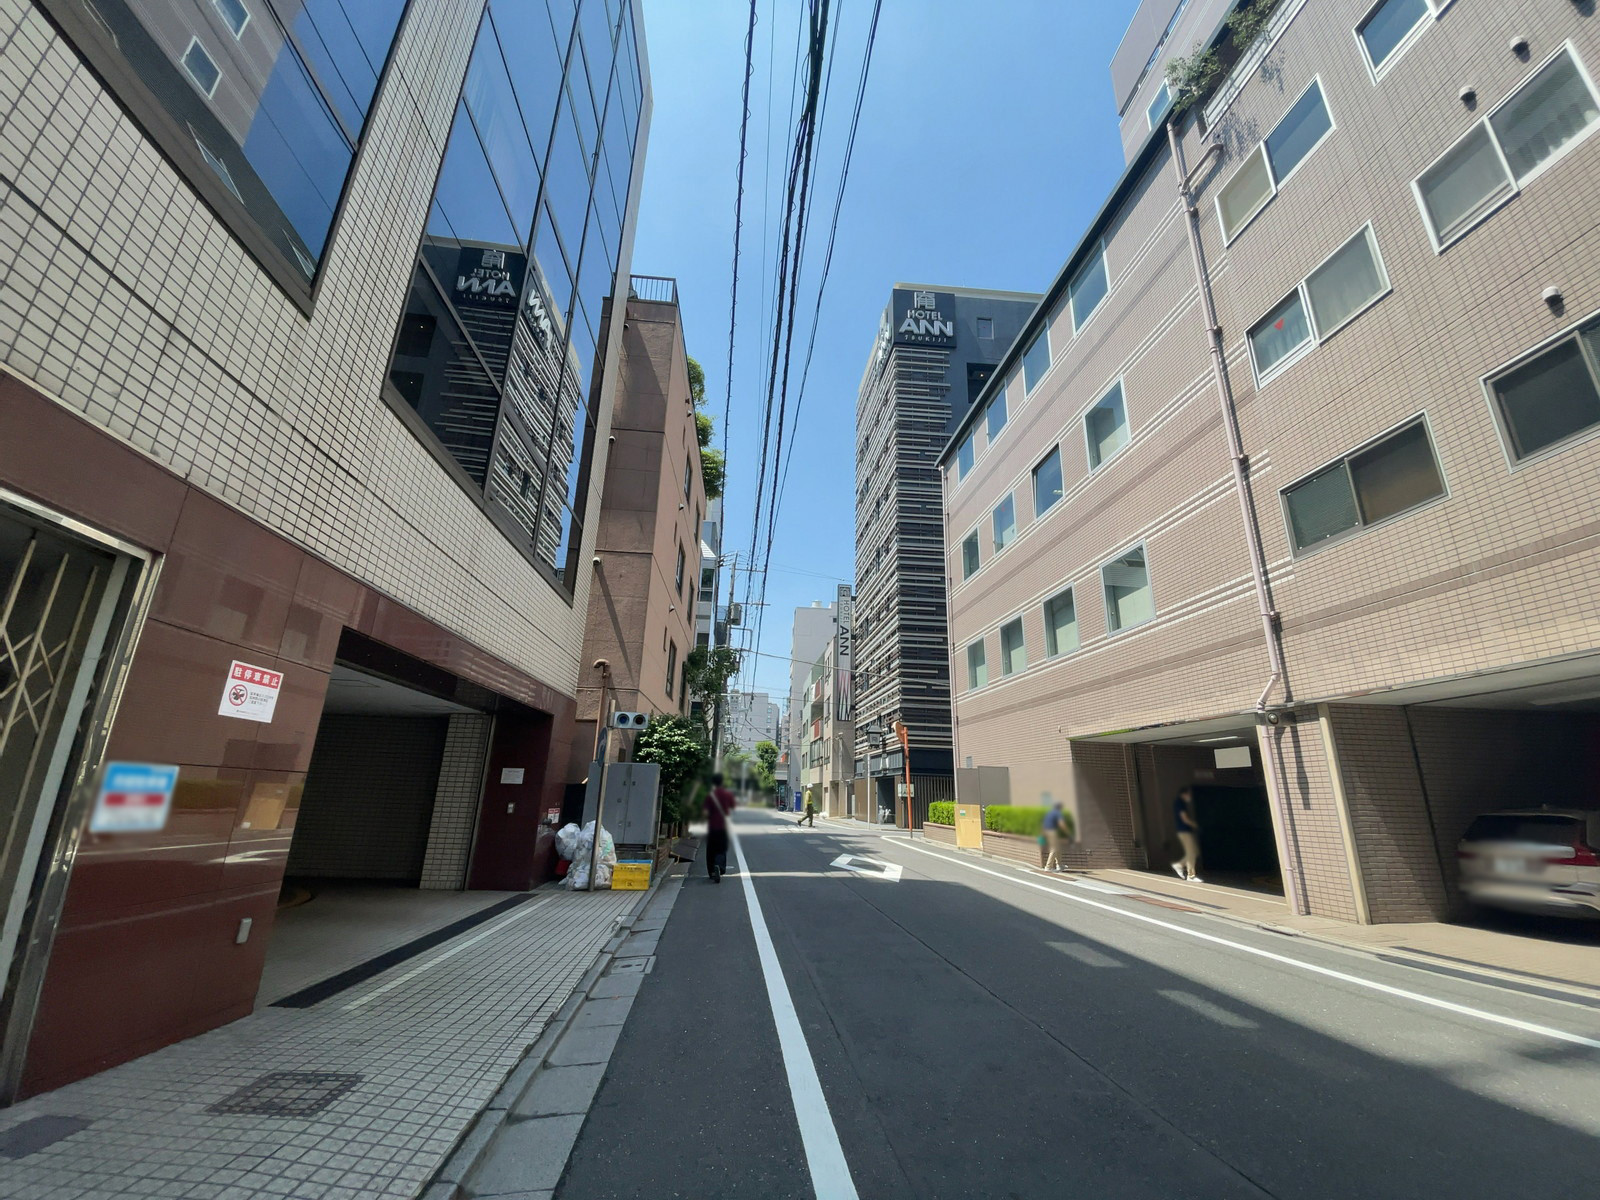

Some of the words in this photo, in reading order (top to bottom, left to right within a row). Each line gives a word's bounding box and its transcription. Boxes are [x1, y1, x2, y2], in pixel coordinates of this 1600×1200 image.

[907, 309, 943, 320] HOTEL
[899, 318, 954, 337] ANN
[904, 334, 947, 343] TSUKIJI
[840, 625, 850, 656] ANN
[233, 666, 279, 687] 駐停車禁止
